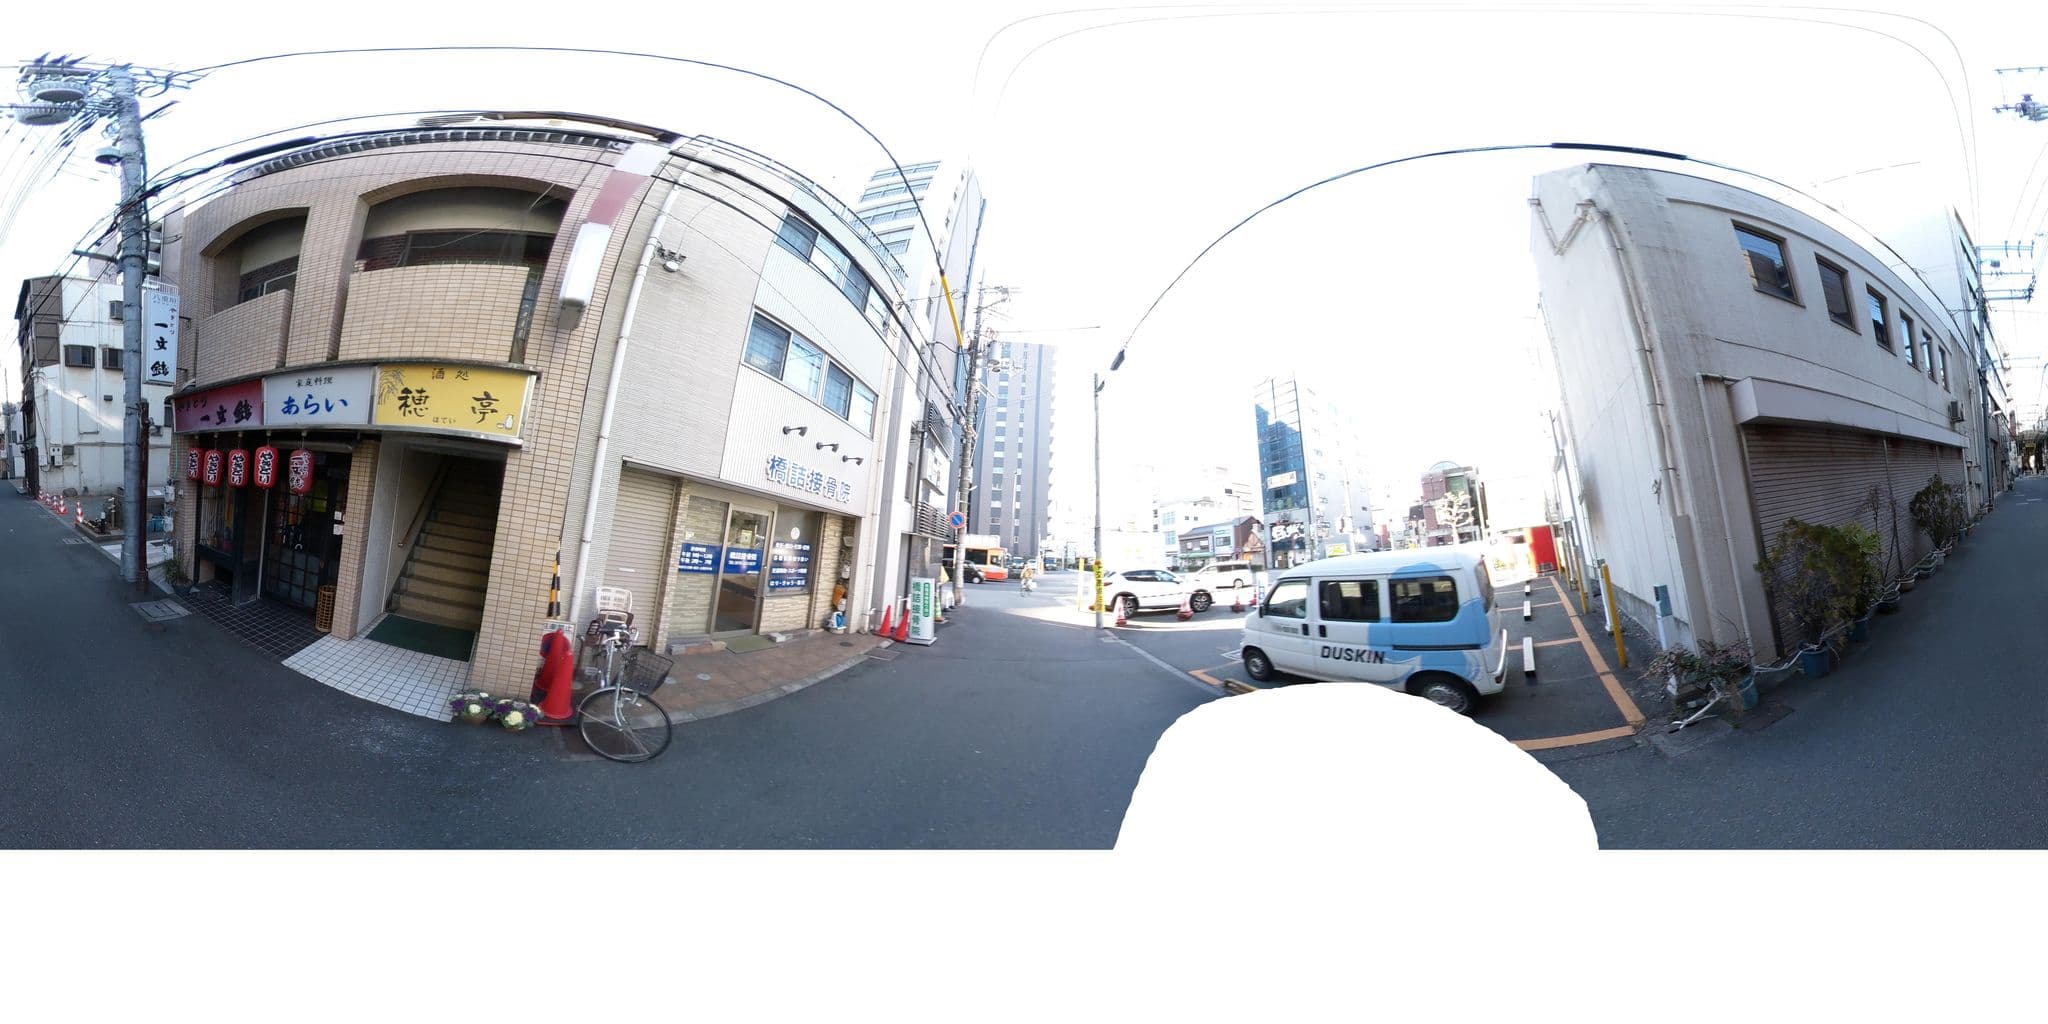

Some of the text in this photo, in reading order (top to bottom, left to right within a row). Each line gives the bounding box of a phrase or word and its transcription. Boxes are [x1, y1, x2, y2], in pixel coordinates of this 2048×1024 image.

[296, 376, 334, 388] 家庭料理
[431, 367, 471, 381] 酒処
[281, 394, 349, 415] あらい
[207, 453, 220, 483] やきとり
[231, 452, 245, 485] やきとり
[259, 450, 275, 485] やきとり
[767, 455, 851, 503] 橋詰接骨院
[1321, 645, 1386, 665] DUSKIN
